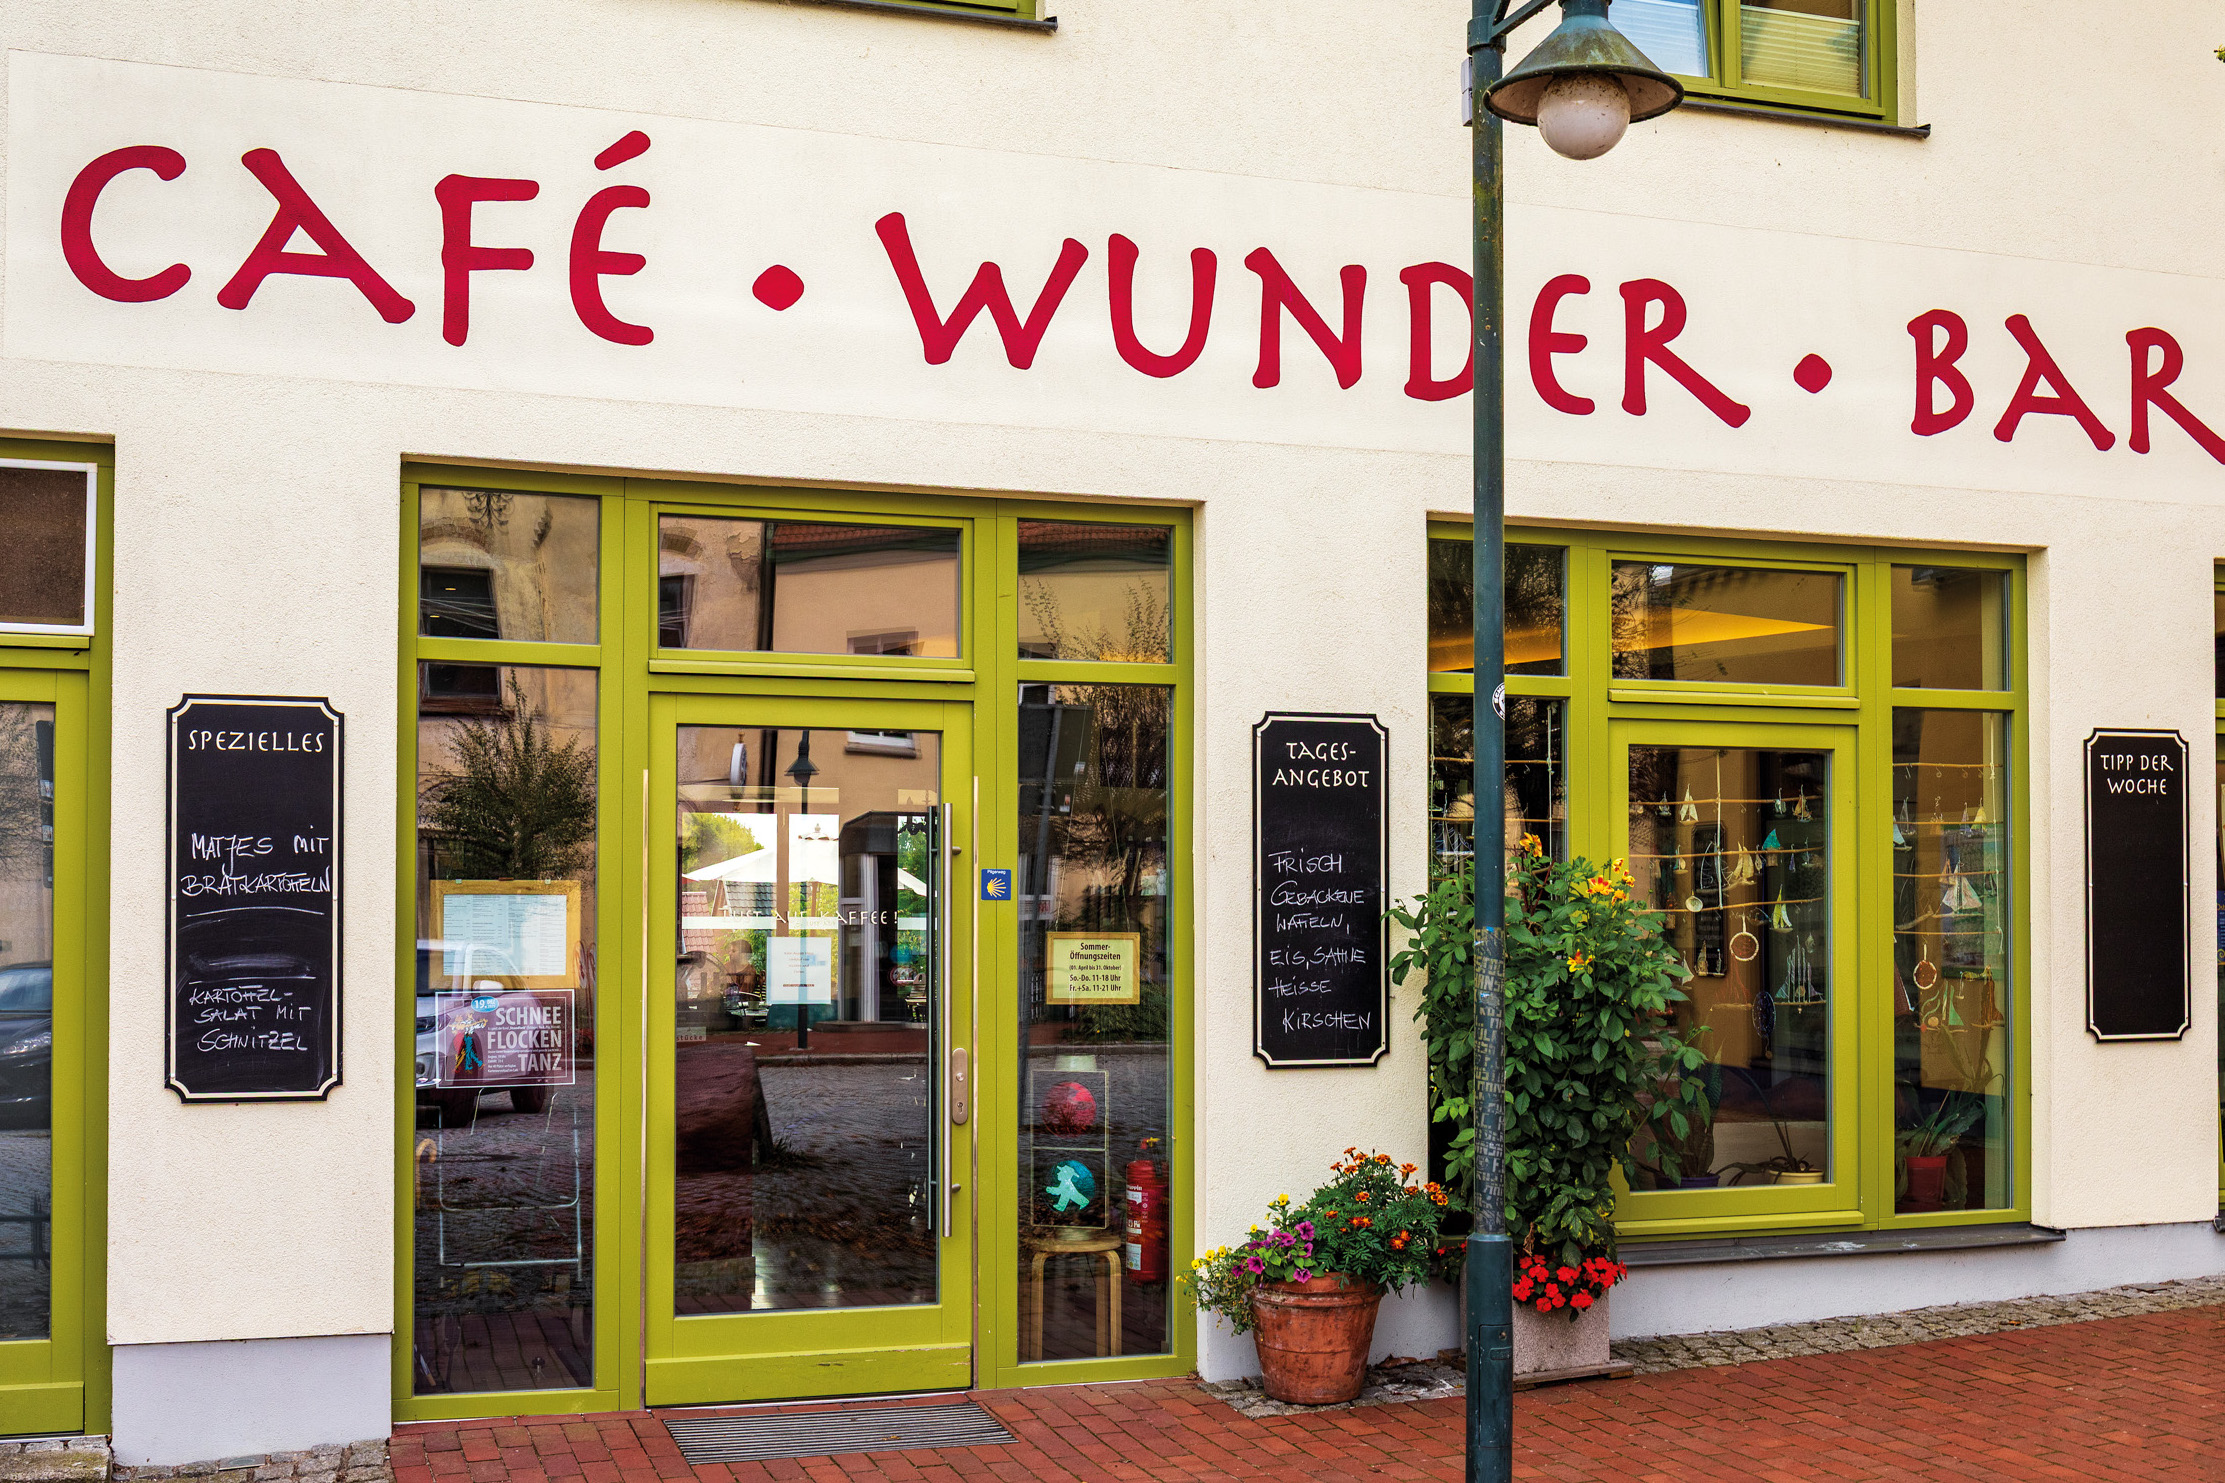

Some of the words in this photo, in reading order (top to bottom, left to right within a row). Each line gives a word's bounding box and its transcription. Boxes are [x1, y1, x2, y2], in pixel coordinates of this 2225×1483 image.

[61, 131, 654, 346] CAFÉ
[876, 213, 1750, 427] WUNDER
[1907, 309, 2225, 464] BAR
[188, 729, 325, 752] SPEZIELLES
[1285, 741, 1357, 761] TAGES-
[2100, 754, 2134, 771] TIPP
[2140, 755, 2174, 772] DER
[1272, 768, 1370, 788] ANGEBOT
[2106, 777, 2167, 795] WOCHE
[1080, 942, 1111, 951] Sommer-
[1069, 952, 1121, 961] Öffnungszeiten
[1110, 974, 1121, 982] Uhr
[1110, 984, 1122, 992] Uhr
[474, 999, 487, 1009] 19.
[495, 1006, 562, 1026] SCHNEE
[487, 1030, 562, 1050] FLOCKEN
[517, 1053, 562, 1072] TANZ
